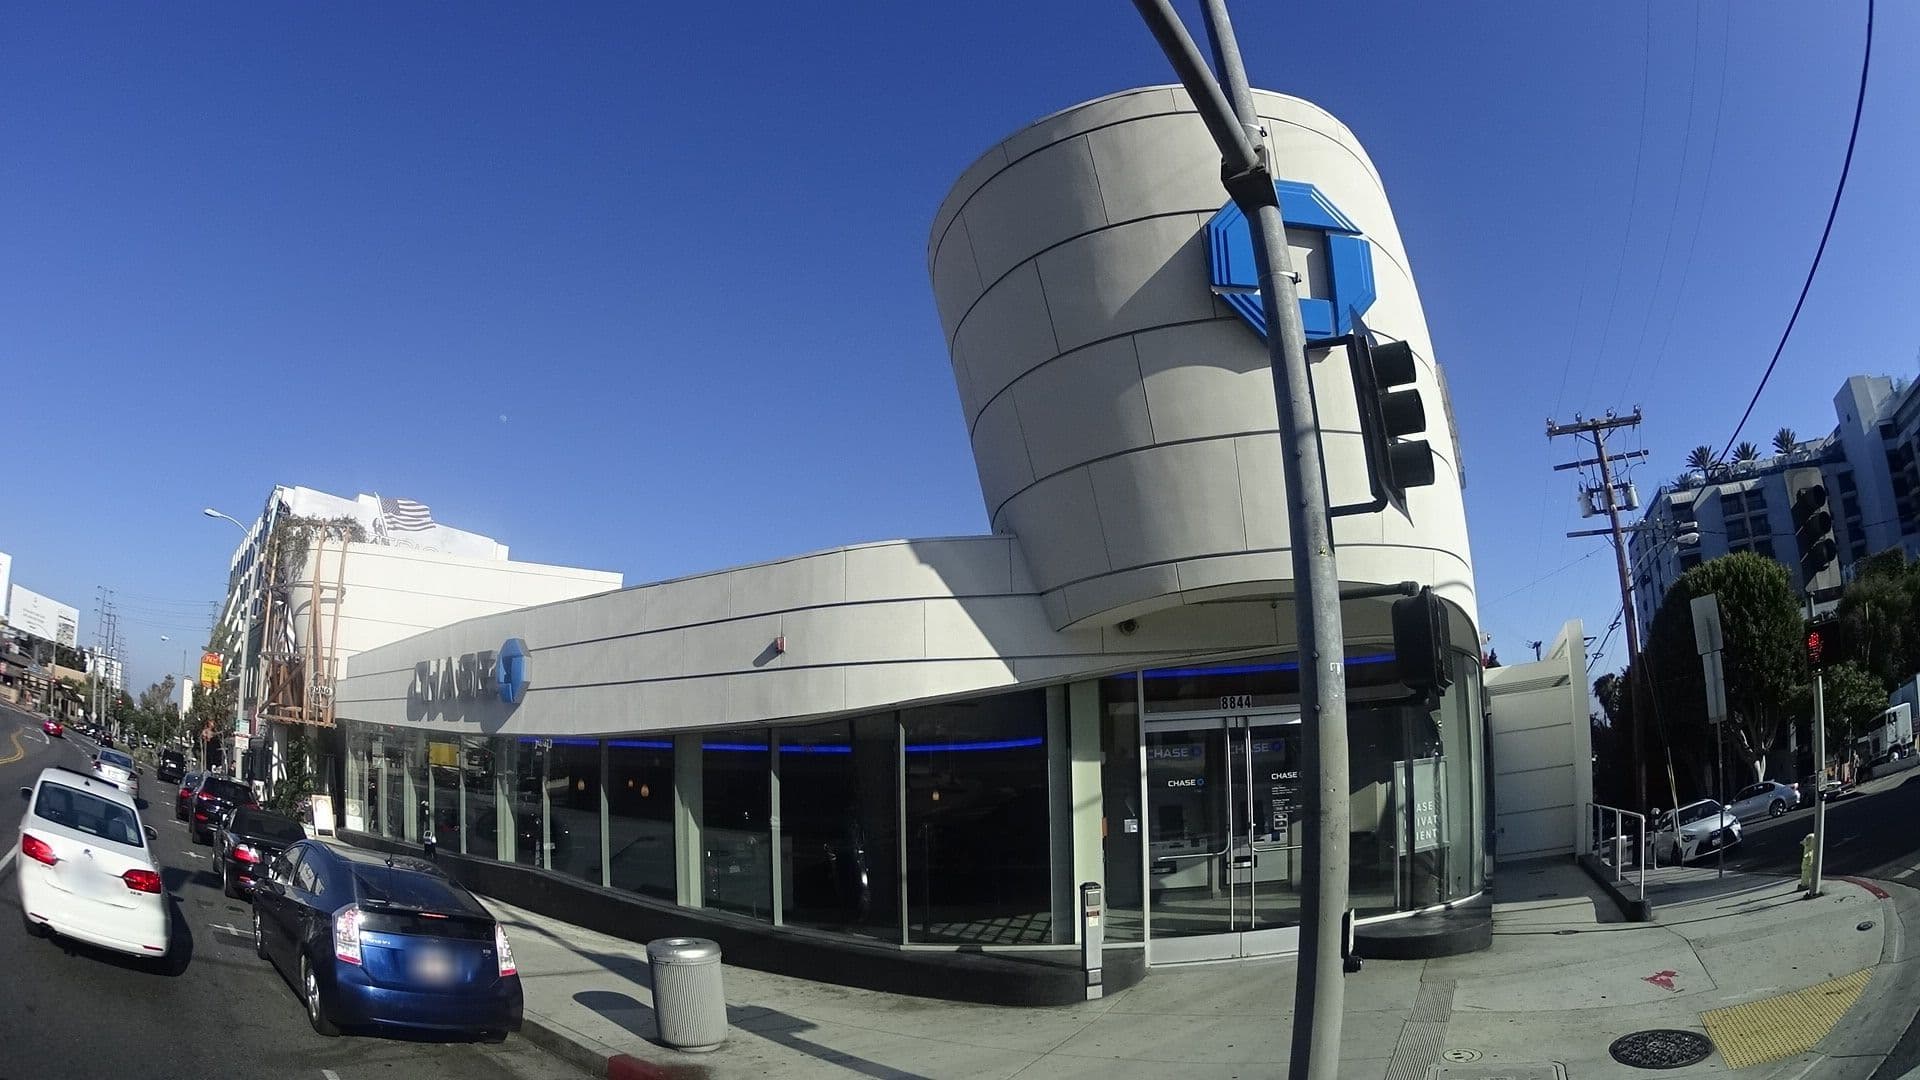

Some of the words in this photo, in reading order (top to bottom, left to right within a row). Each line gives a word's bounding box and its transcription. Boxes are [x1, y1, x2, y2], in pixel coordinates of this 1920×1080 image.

[1221, 696, 1251, 709] 8844
[1147, 748, 1189, 759] CHASE
[1271, 772, 1298, 780] CHASE
[1167, 779, 1196, 787] CHASE
